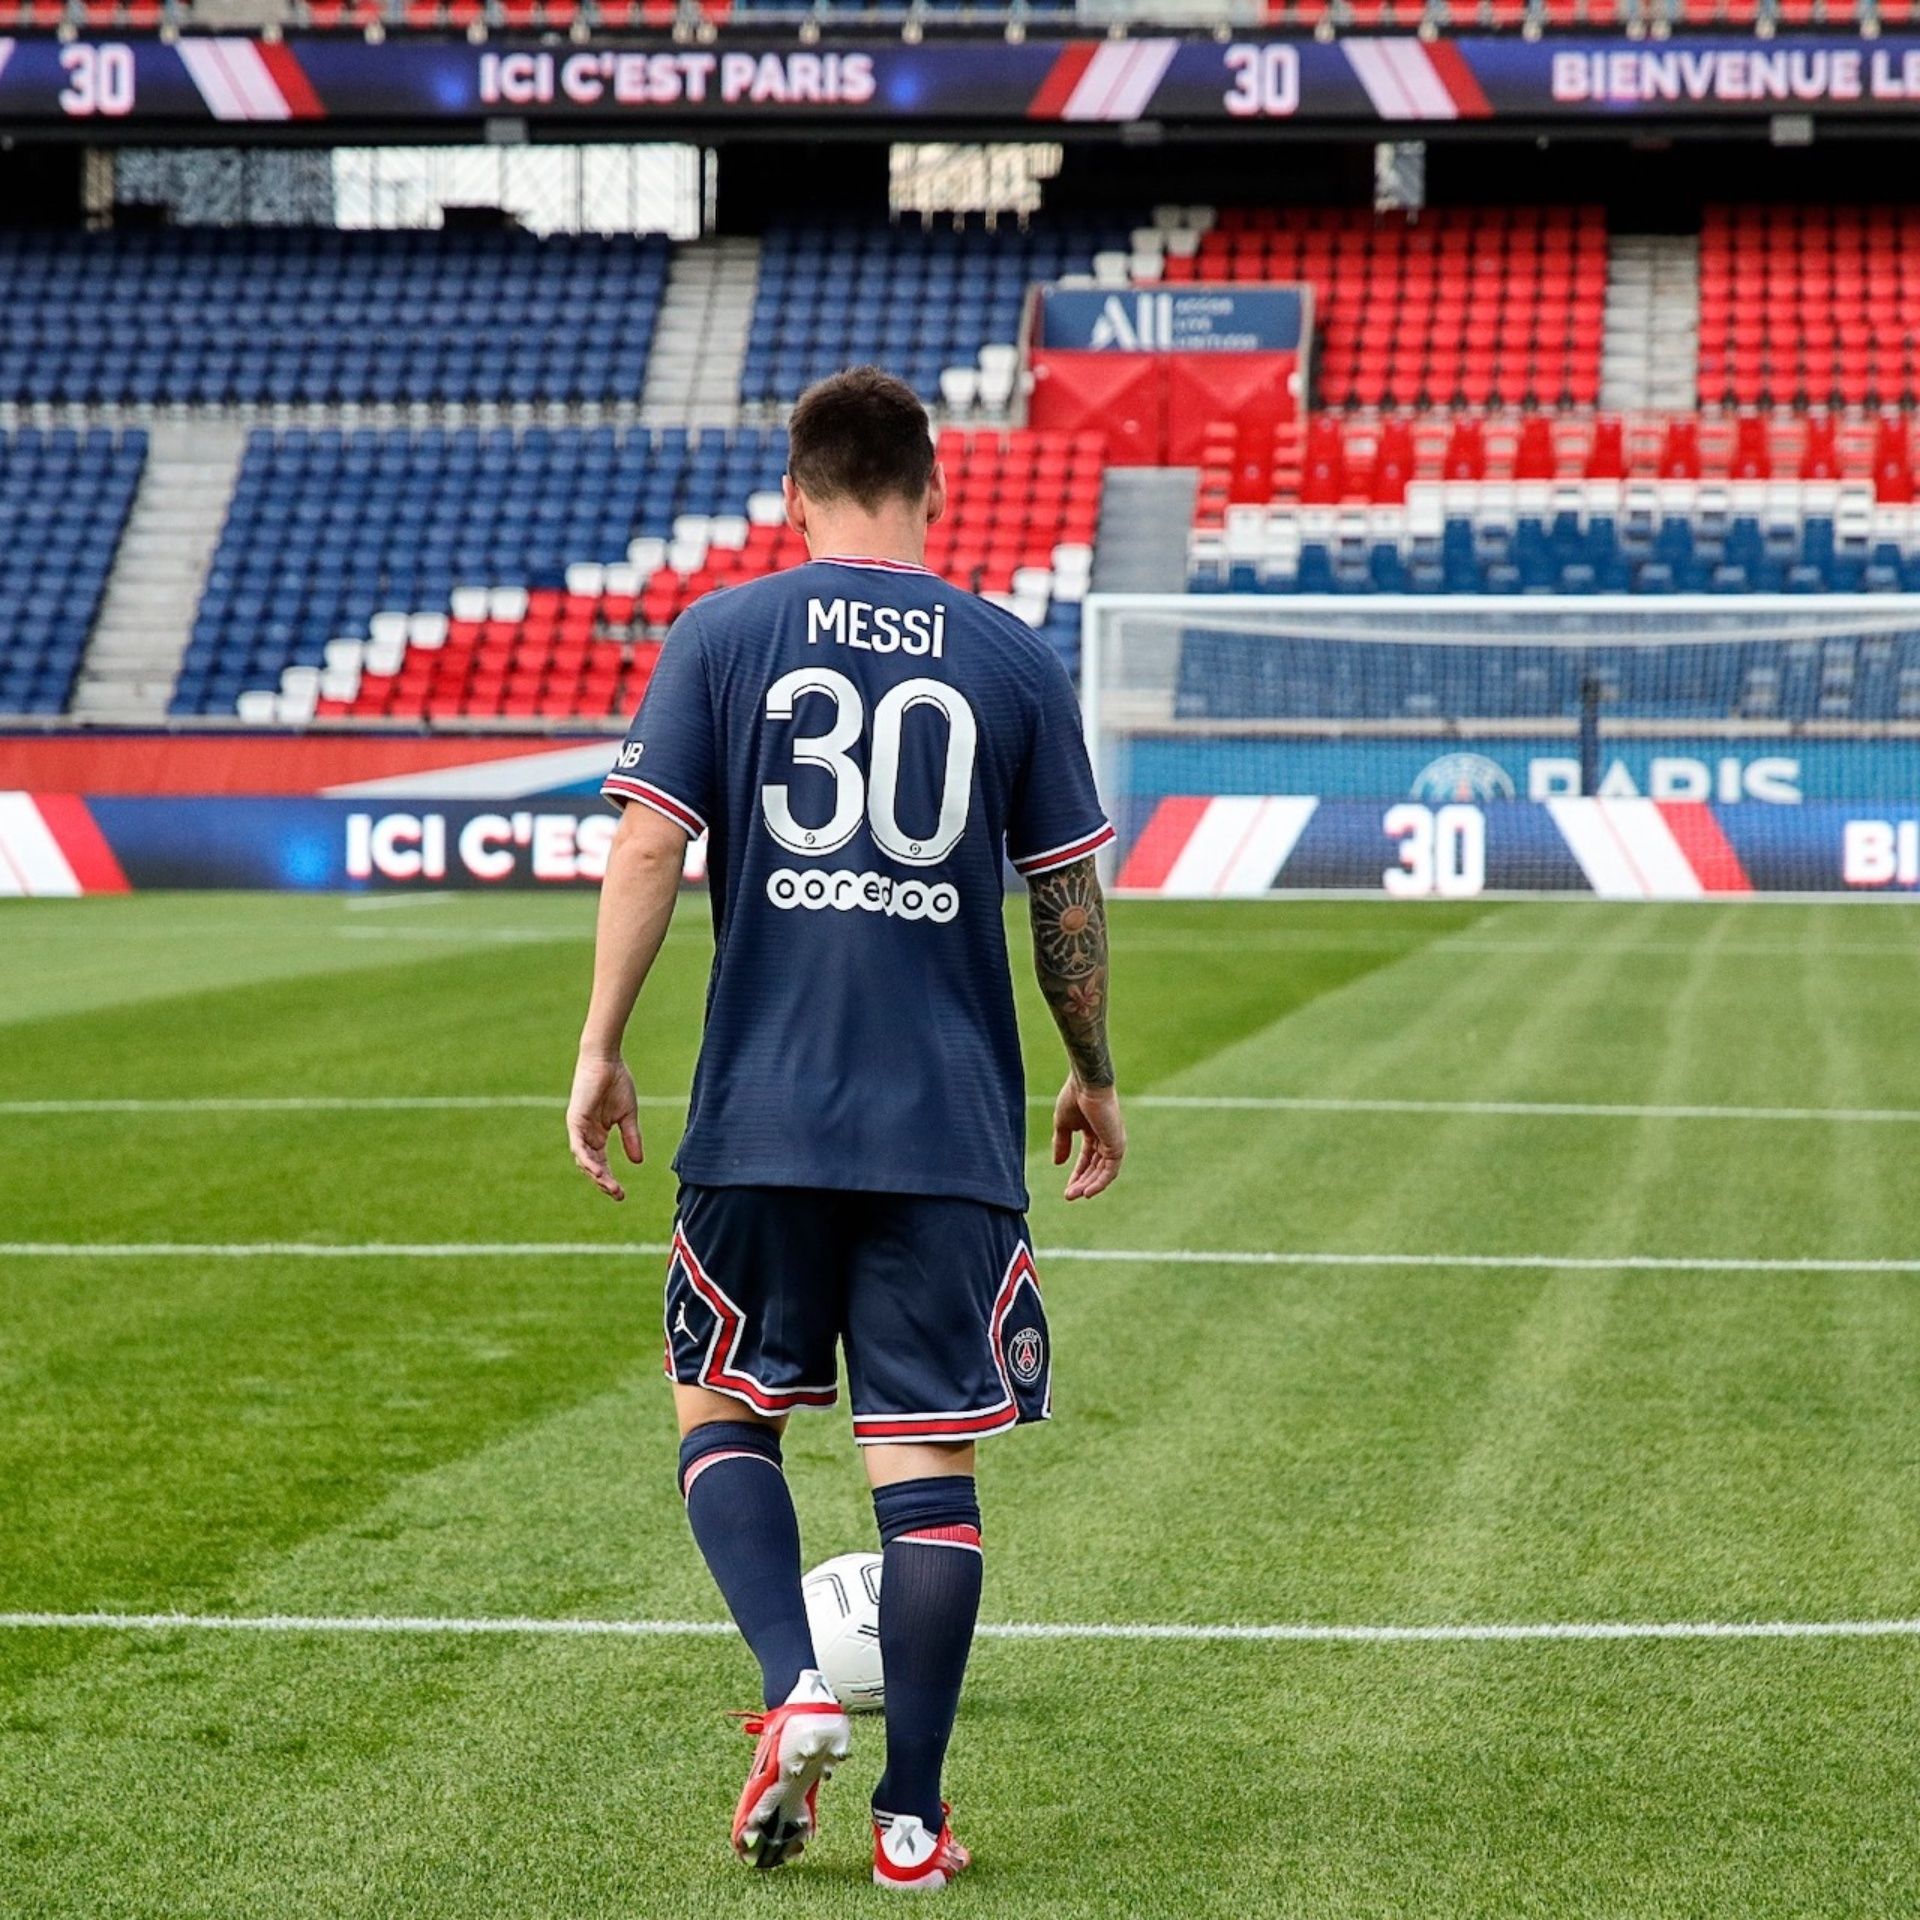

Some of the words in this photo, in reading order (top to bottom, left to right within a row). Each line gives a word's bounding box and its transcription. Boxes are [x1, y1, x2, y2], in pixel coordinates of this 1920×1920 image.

[59, 44, 135, 115] 30
[479, 53, 553, 102] ICI
[561, 52, 715, 102] C'EST
[721, 53, 875, 102] PARIS
[1222, 44, 1300, 116] 30
[1552, 50, 1862, 99] BIENVENUE
[762, 667, 977, 867] 30
[346, 813, 446, 880] ICI
[458, 811, 619, 881] C'ES
[1382, 803, 1486, 897] 30
[767, 869, 959, 923] ooredoo
